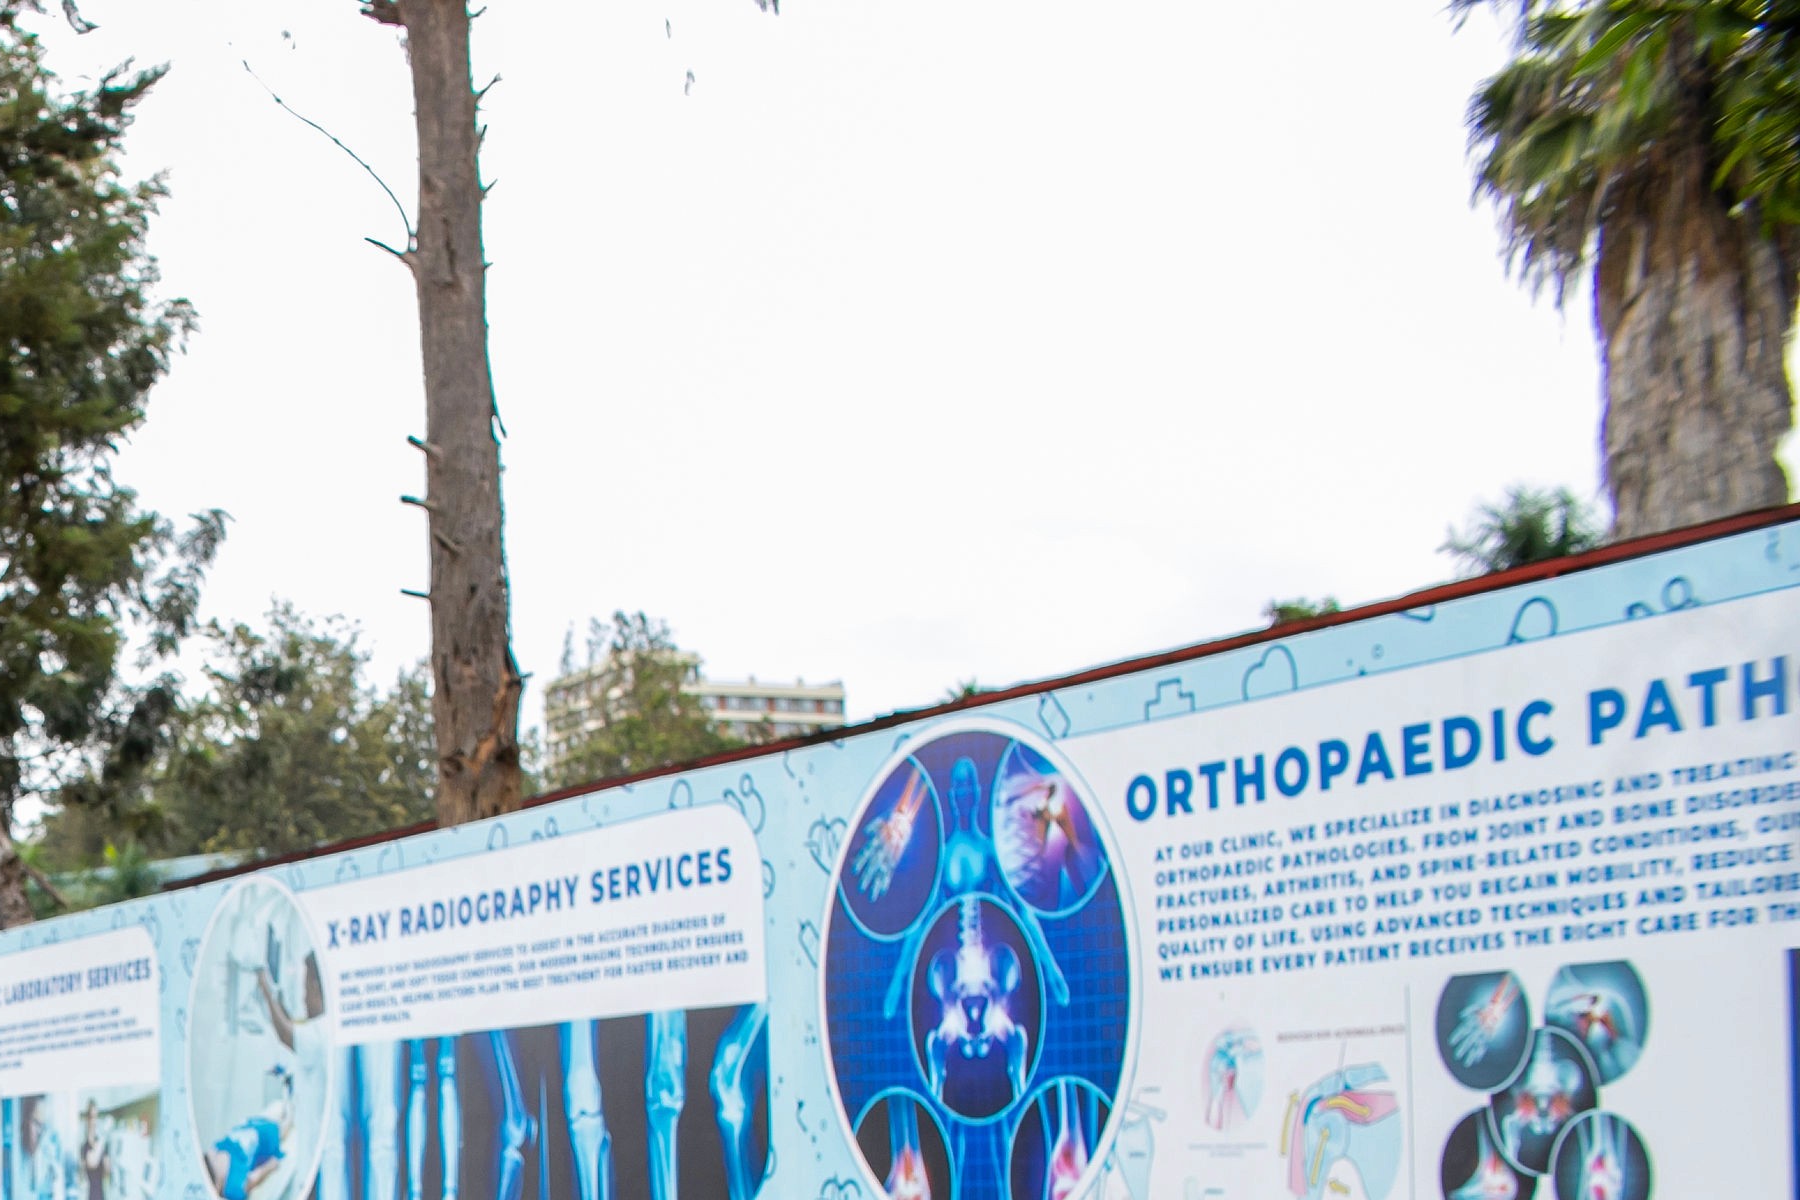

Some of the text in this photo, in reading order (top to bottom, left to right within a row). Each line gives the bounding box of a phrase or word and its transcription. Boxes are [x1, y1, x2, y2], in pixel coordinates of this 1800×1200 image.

[1125, 654, 1800, 824] ORTHOPAEDIC PATH
[1155, 751, 1796, 863] AT OUR CLINIC, WE SPECIALIZE IN DIAGNOSING AND TREATING
[1155, 856, 1274, 887] ORTHOPAEDIC
[1280, 837, 1416, 870] PATHOLOGIES.
[1422, 828, 1479, 849] FROM
[1487, 817, 1548, 842] JOINT
[1558, 808, 1604, 830] AND
[1612, 799, 1677, 824] BONE
[327, 847, 733, 950] X-RAY RADIOGRAPHY SERVICES
[1156, 885, 1258, 910] FRACTURES,
[1263, 869, 1365, 897] ARTHRITIS,
[1371, 863, 1411, 883] AND
[1418, 840, 1583, 877] SPINE-RELATED
[1590, 819, 1749, 855] CONDITIONS,
[1157, 841, 1795, 934] PERSONALIZED CARE TO HELP YOU REGAIN MOBILITY, REDUCE
[667, 952, 723, 970] RECOVERY
[725, 948, 749, 964] AND
[1157, 937, 1228, 960] QUALITY
[1233, 934, 1255, 951] OF
[1261, 928, 1305, 948] LIFE.
[1310, 920, 1366, 943] USING
[1374, 907, 1482, 935] ADVANCED
[1489, 891, 1627, 923] TECHNIQUES
[1636, 885, 1687, 907] AND
[1158, 964, 1185, 982] WE
[1190, 957, 1255, 979] ENSURE
[1261, 951, 1317, 974] EVERY
[1323, 942, 1401, 966] PATIENT
[1408, 931, 1505, 957] RECEIVES
[1512, 926, 1553, 947] THE
[1561, 919, 1627, 942] RIGHT
[1636, 912, 1700, 936] CARE
[1707, 906, 1760, 929] FOR
[5, 971, 84, 1005] LABORATORY
[87, 957, 152, 990] SERVICES
